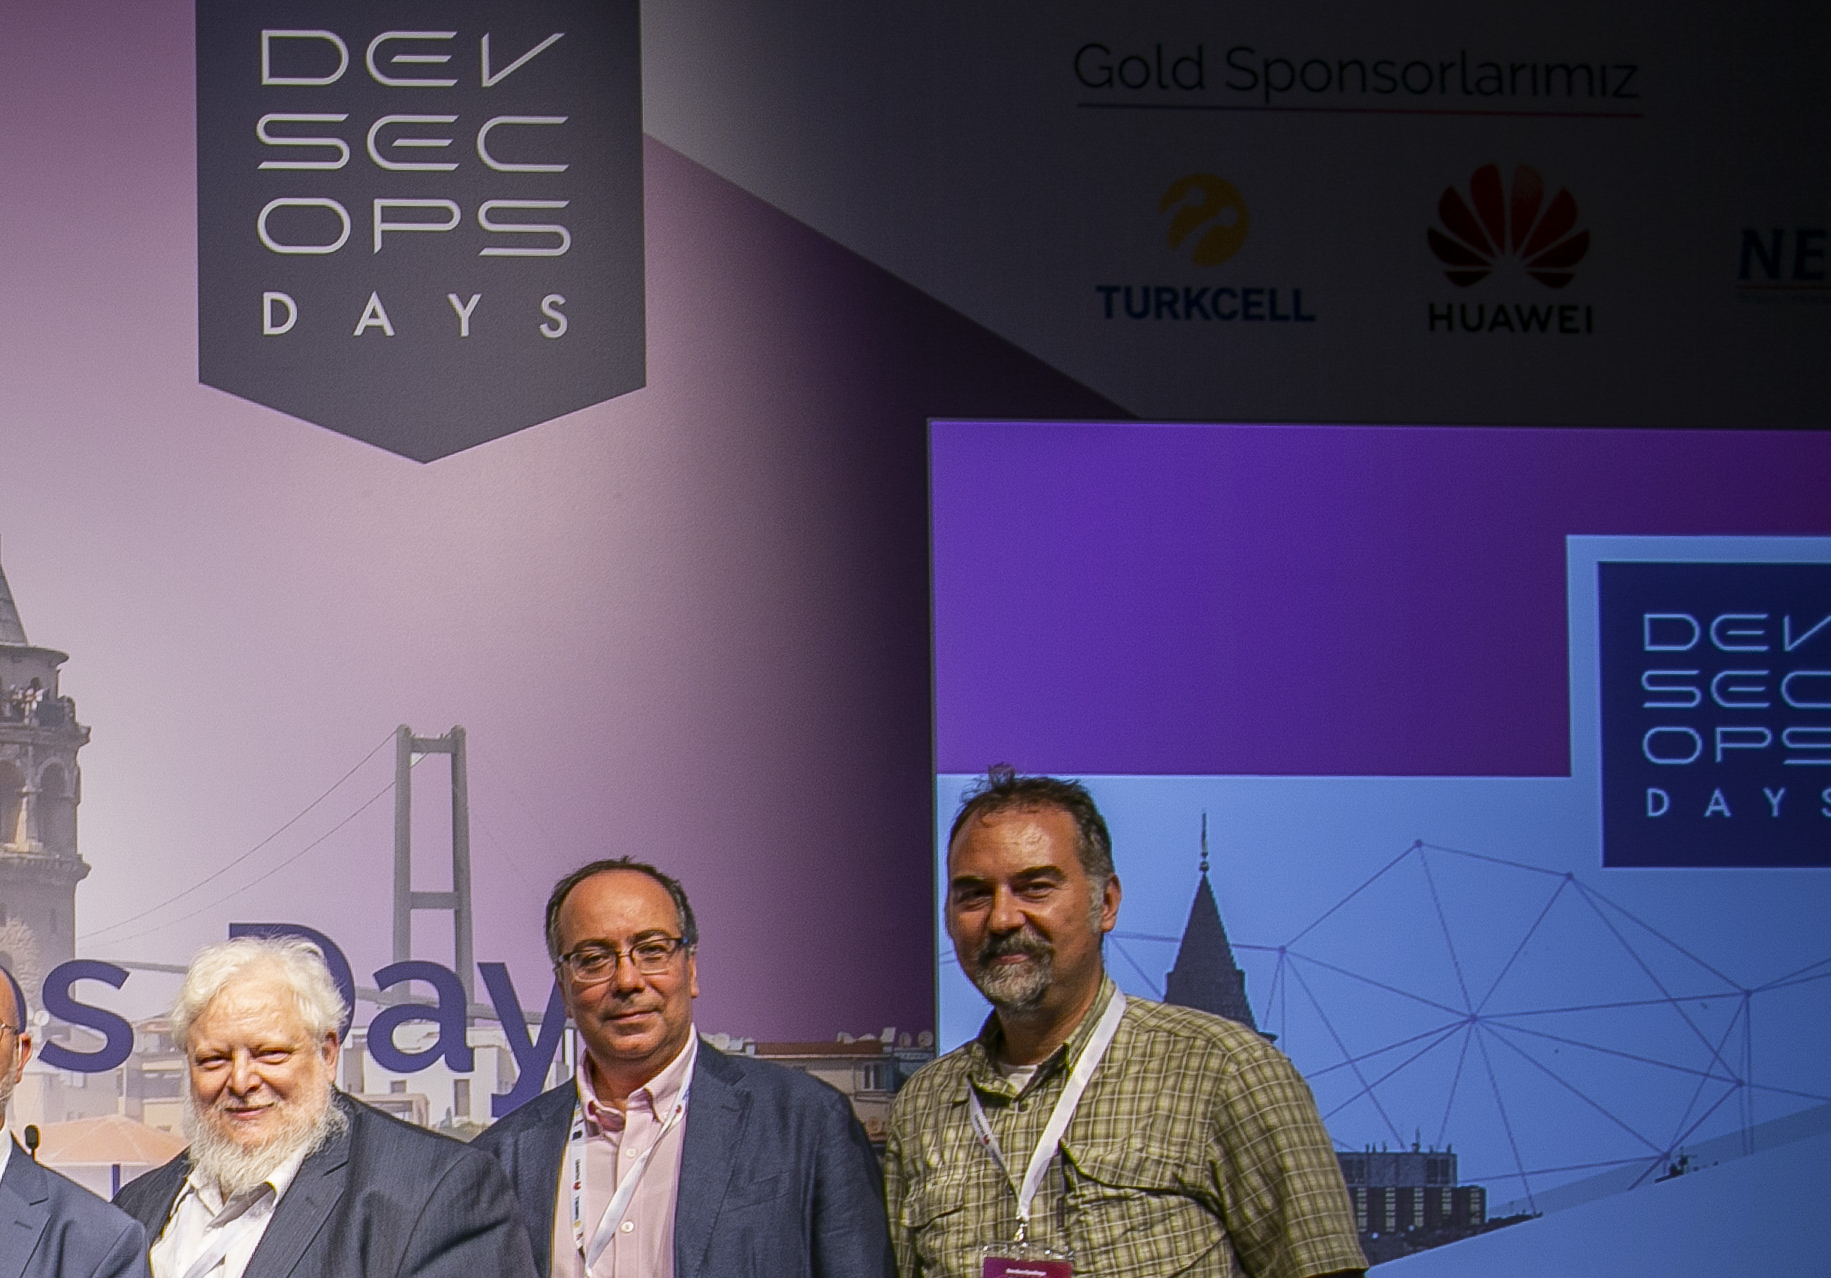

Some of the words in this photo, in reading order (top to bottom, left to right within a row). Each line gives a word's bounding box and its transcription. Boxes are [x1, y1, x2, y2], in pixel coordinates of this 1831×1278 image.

[261, 29, 565, 87] DEV
[1073, 42, 1205, 91] Gold
[1225, 46, 1641, 104] Sponsorlarımız
[256, 113, 569, 172] SEC
[257, 197, 571, 257] OPS
[262, 290, 568, 339] DAYS
[1096, 284, 1316, 323] TURKCELL
[1428, 302, 1594, 334] HUAWEI
[1641, 669, 1831, 708] SEC
[1642, 726, 1831, 765] OPS
